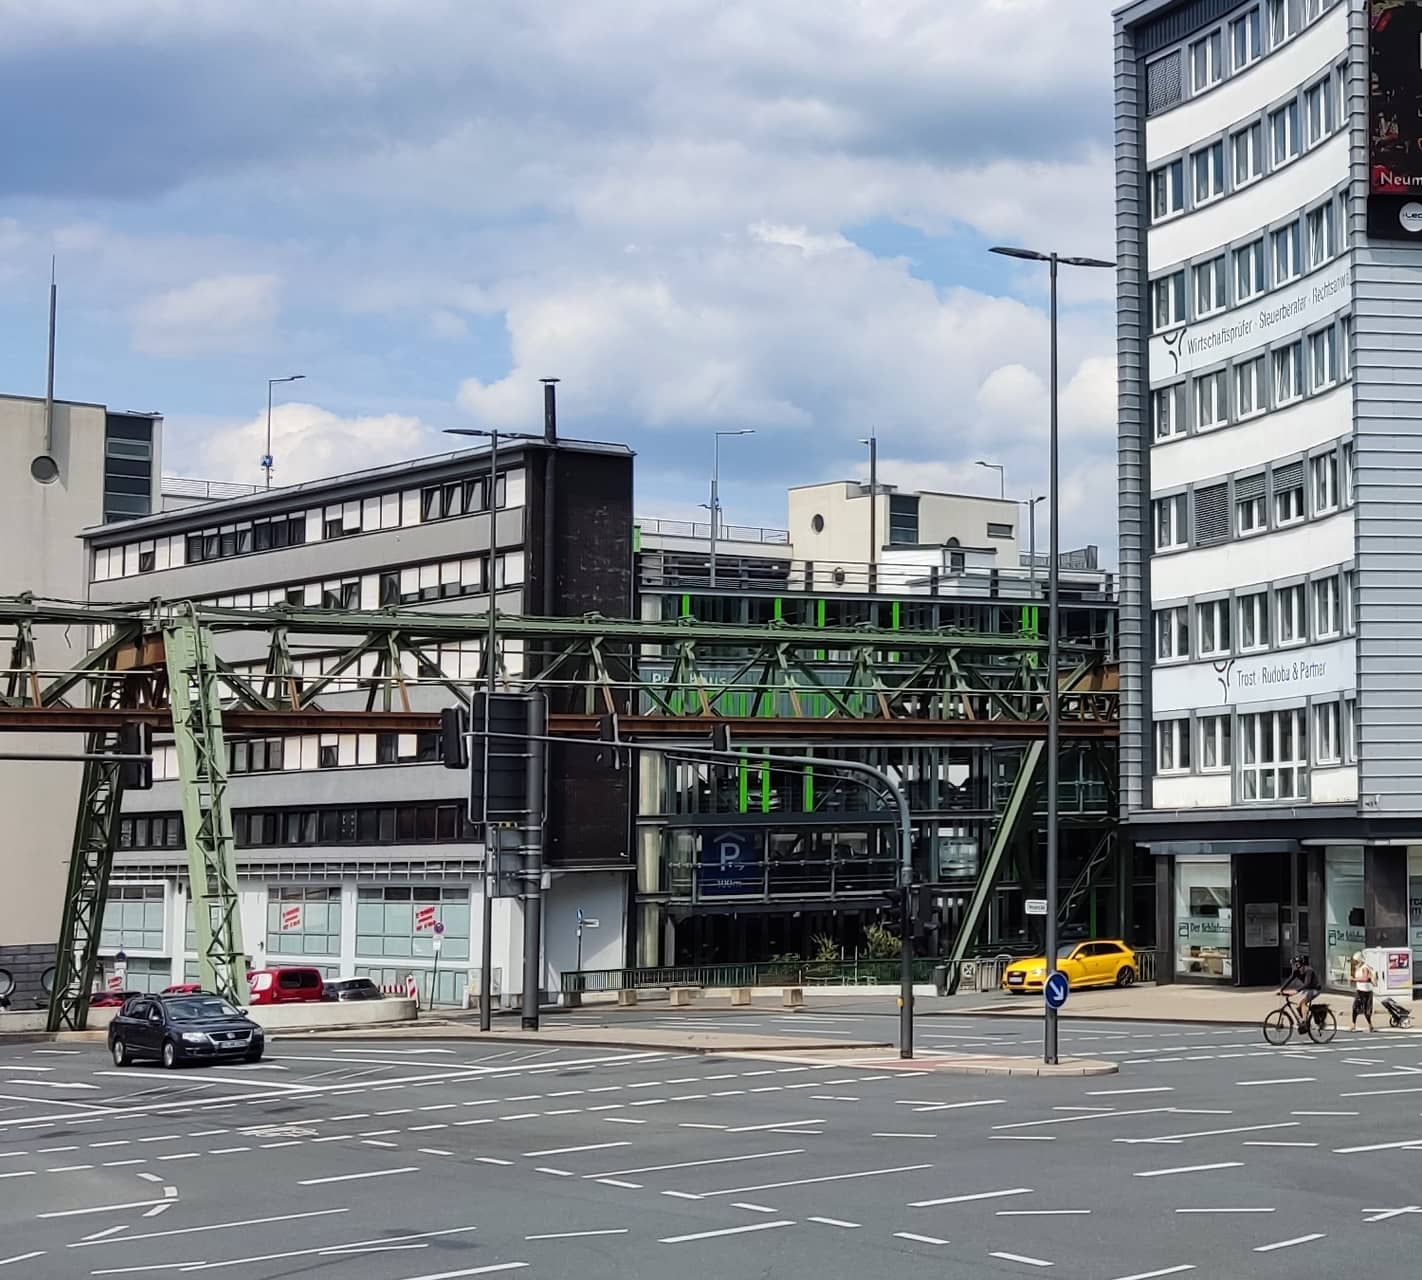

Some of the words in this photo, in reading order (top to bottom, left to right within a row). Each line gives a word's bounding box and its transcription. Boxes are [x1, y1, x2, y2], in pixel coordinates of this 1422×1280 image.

[1259, 297, 1307, 328] Steuerberater
[1237, 669, 1257, 688] Trost
[1262, 665, 1290, 684] Rudoba
[1292, 663, 1298, 681] &
[1300, 661, 1326, 680] Partner
